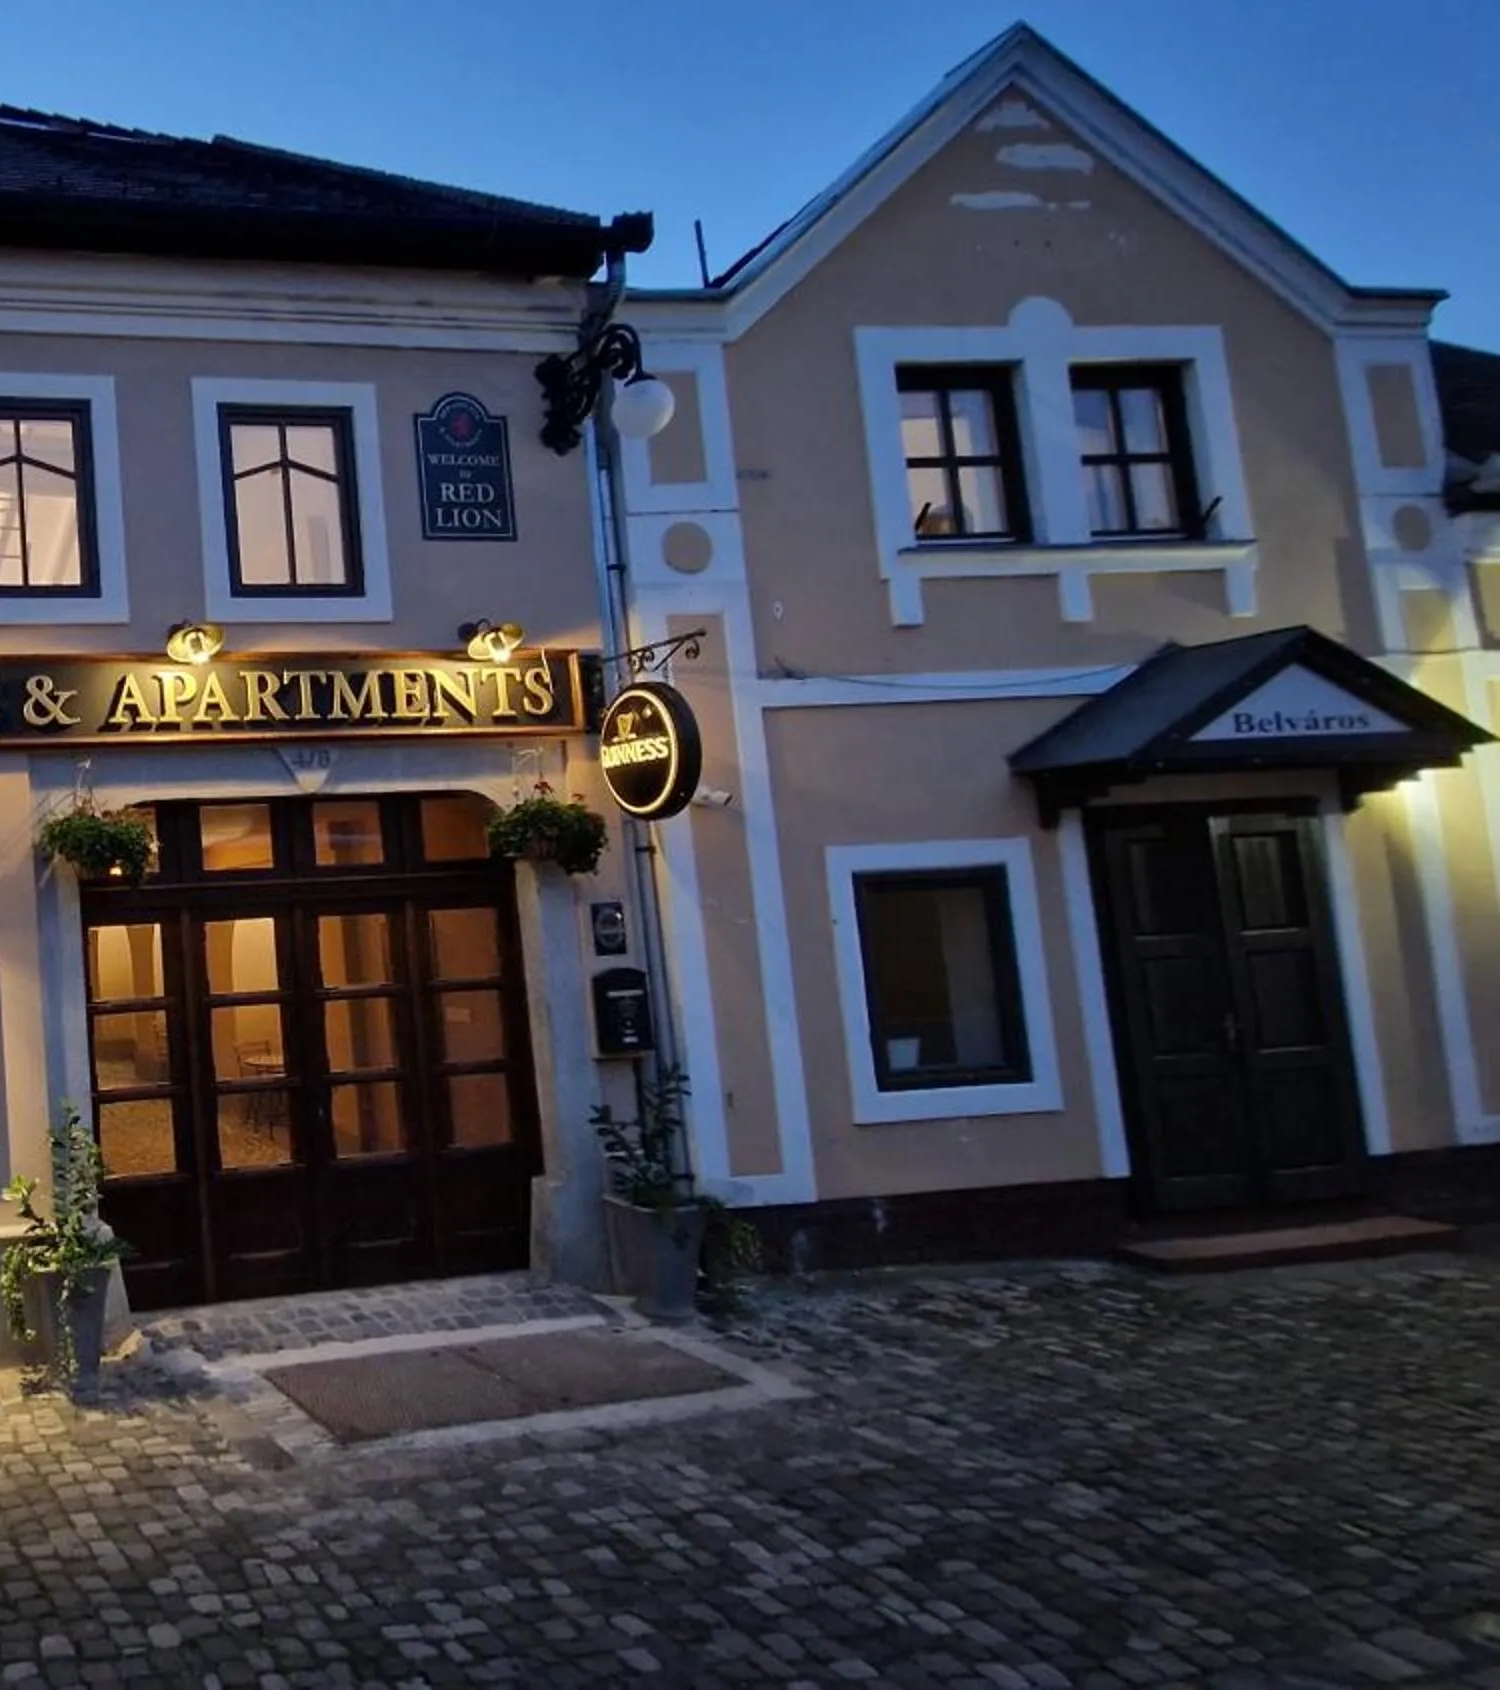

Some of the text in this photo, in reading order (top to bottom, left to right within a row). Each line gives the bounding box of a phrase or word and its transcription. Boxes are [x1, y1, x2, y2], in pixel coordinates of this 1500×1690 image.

[427, 454, 501, 467] WELCOME
[439, 482, 495, 503] RED
[435, 507, 502, 529] LION
[22, 674, 81, 726] &
[107, 667, 553, 725] APARTMENTS
[1232, 709, 1372, 735] Belváros
